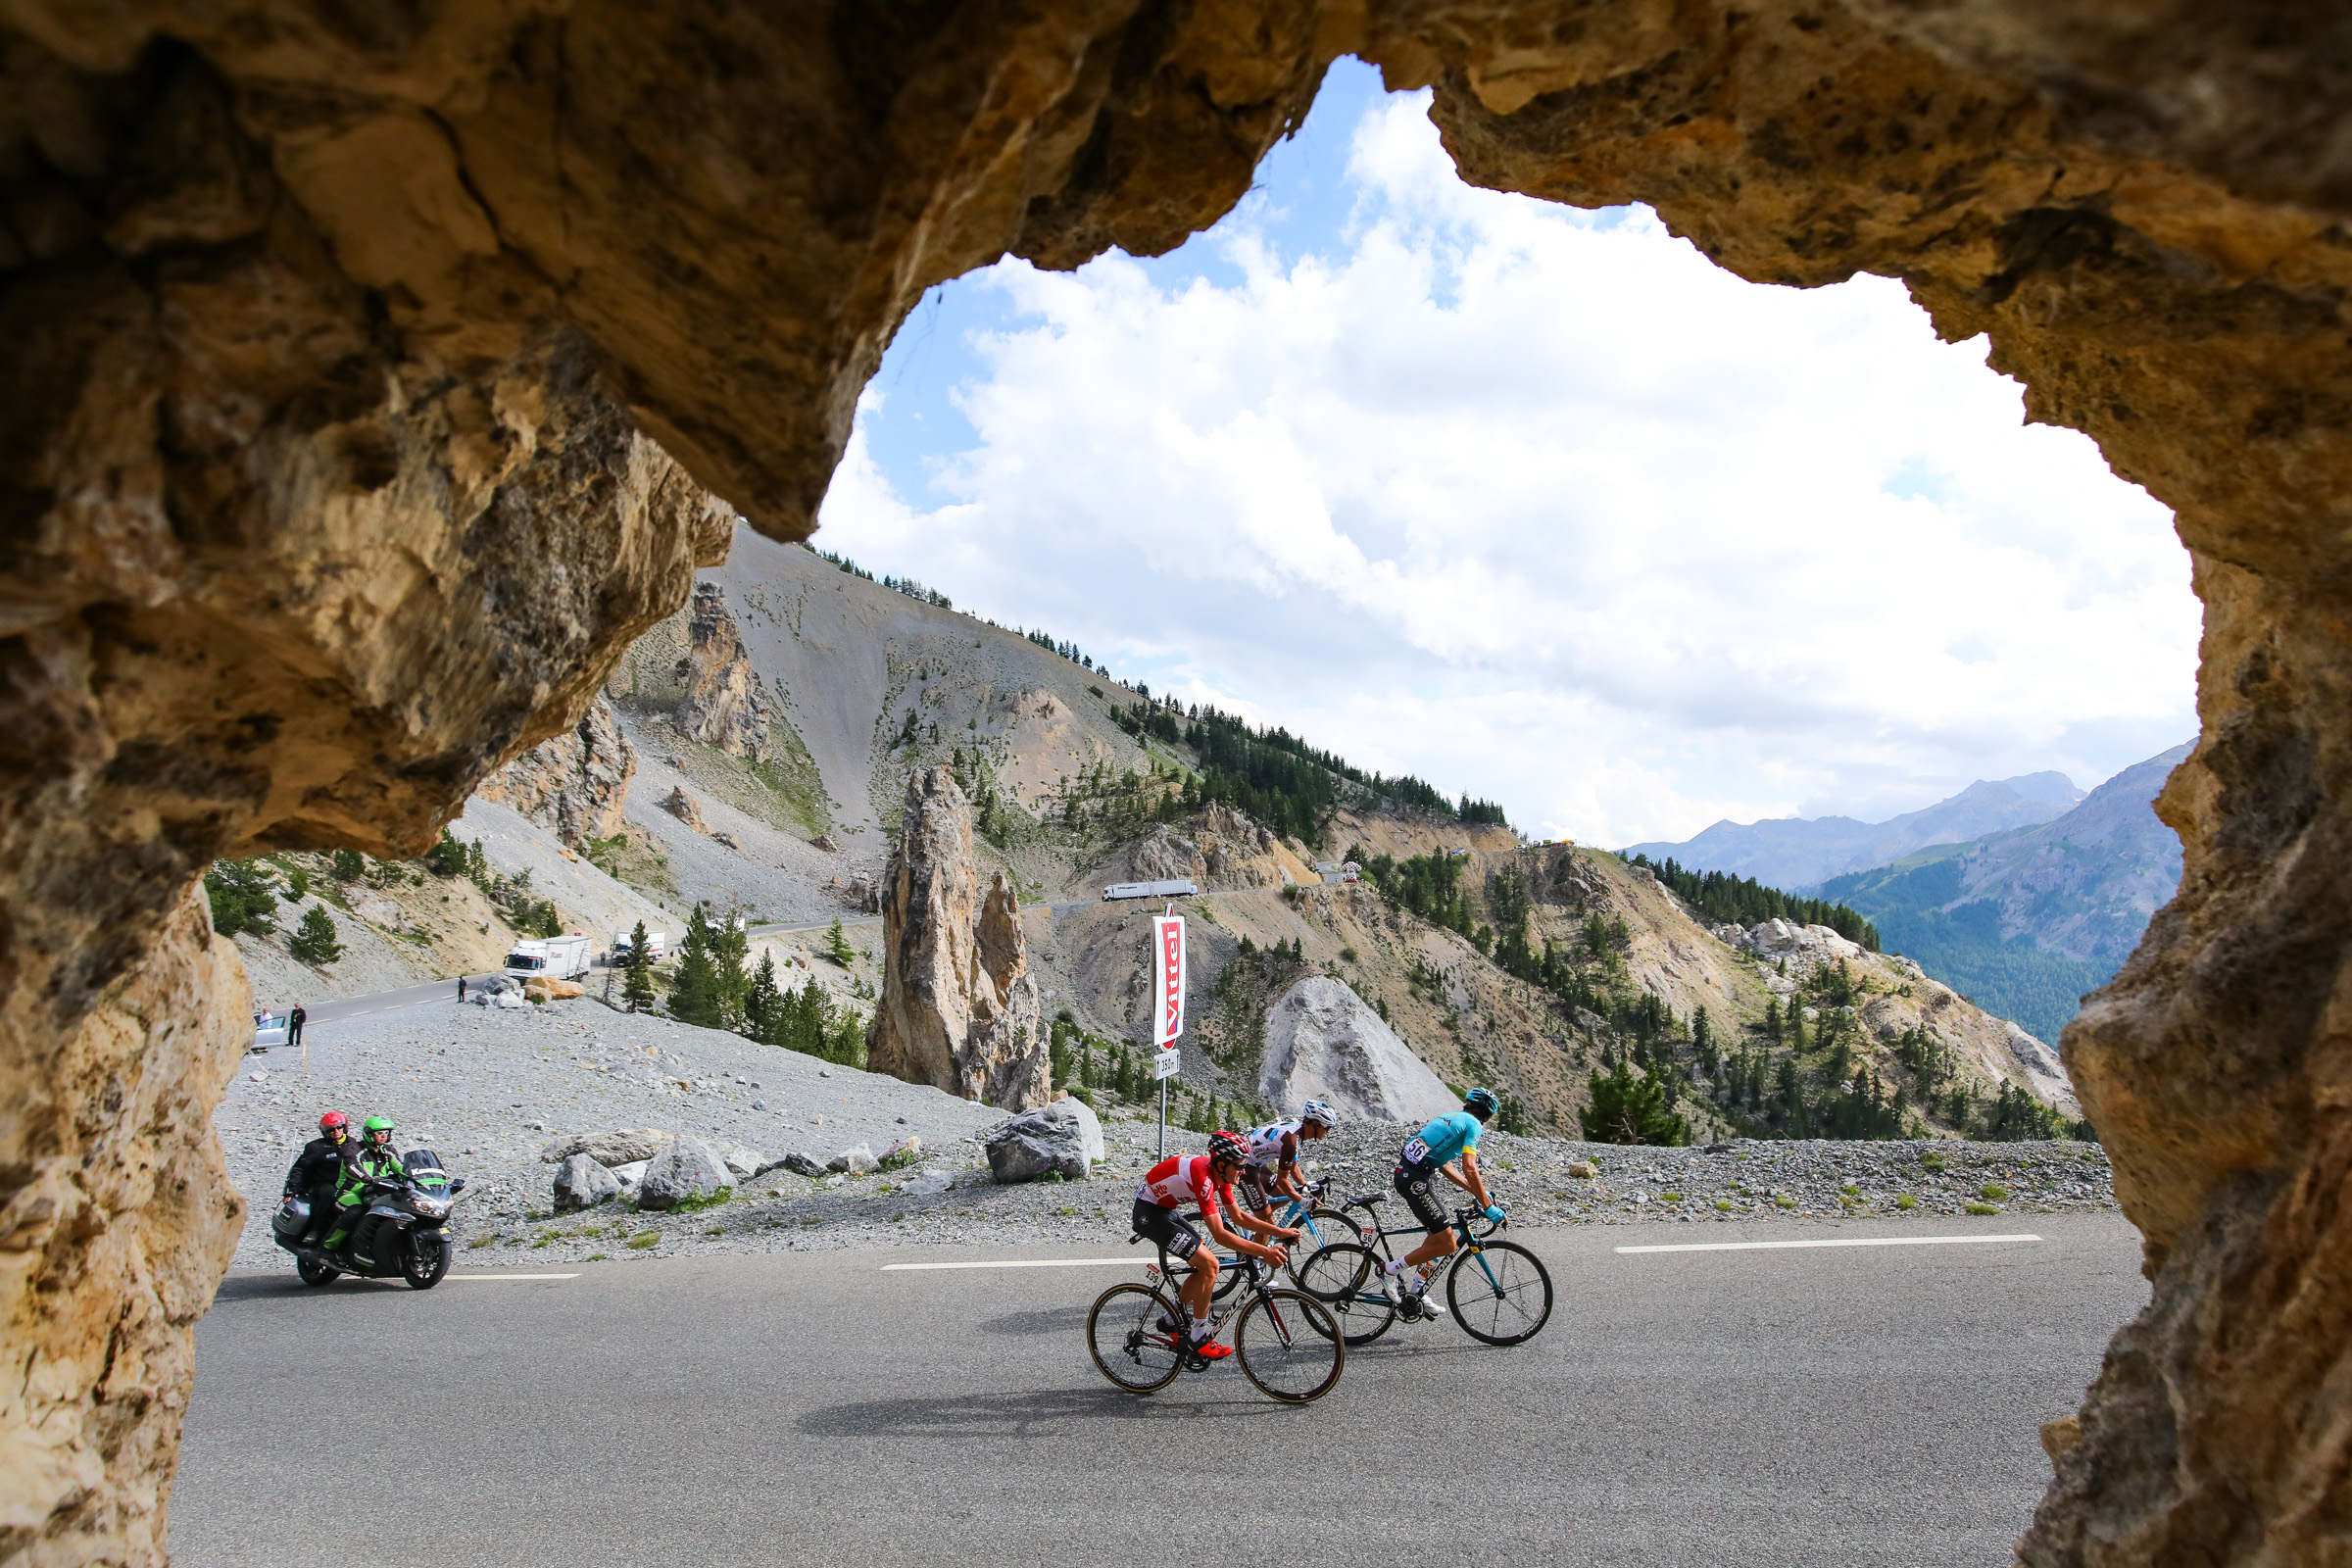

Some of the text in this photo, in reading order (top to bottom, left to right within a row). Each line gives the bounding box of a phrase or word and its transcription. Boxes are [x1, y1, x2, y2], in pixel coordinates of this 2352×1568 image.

[1166, 929, 1180, 1032] Vittel
[1408, 1140, 1426, 1157] 56
[1239, 1179, 1259, 1210] MONDIALE
[1248, 1184, 1264, 1209] AG2R LA
[1363, 1233, 1373, 1243] 56
[1146, 1270, 1159, 1284] 139
[1422, 1254, 1451, 1294] ARGON
[1210, 1284, 1250, 1339] RIDLEY
